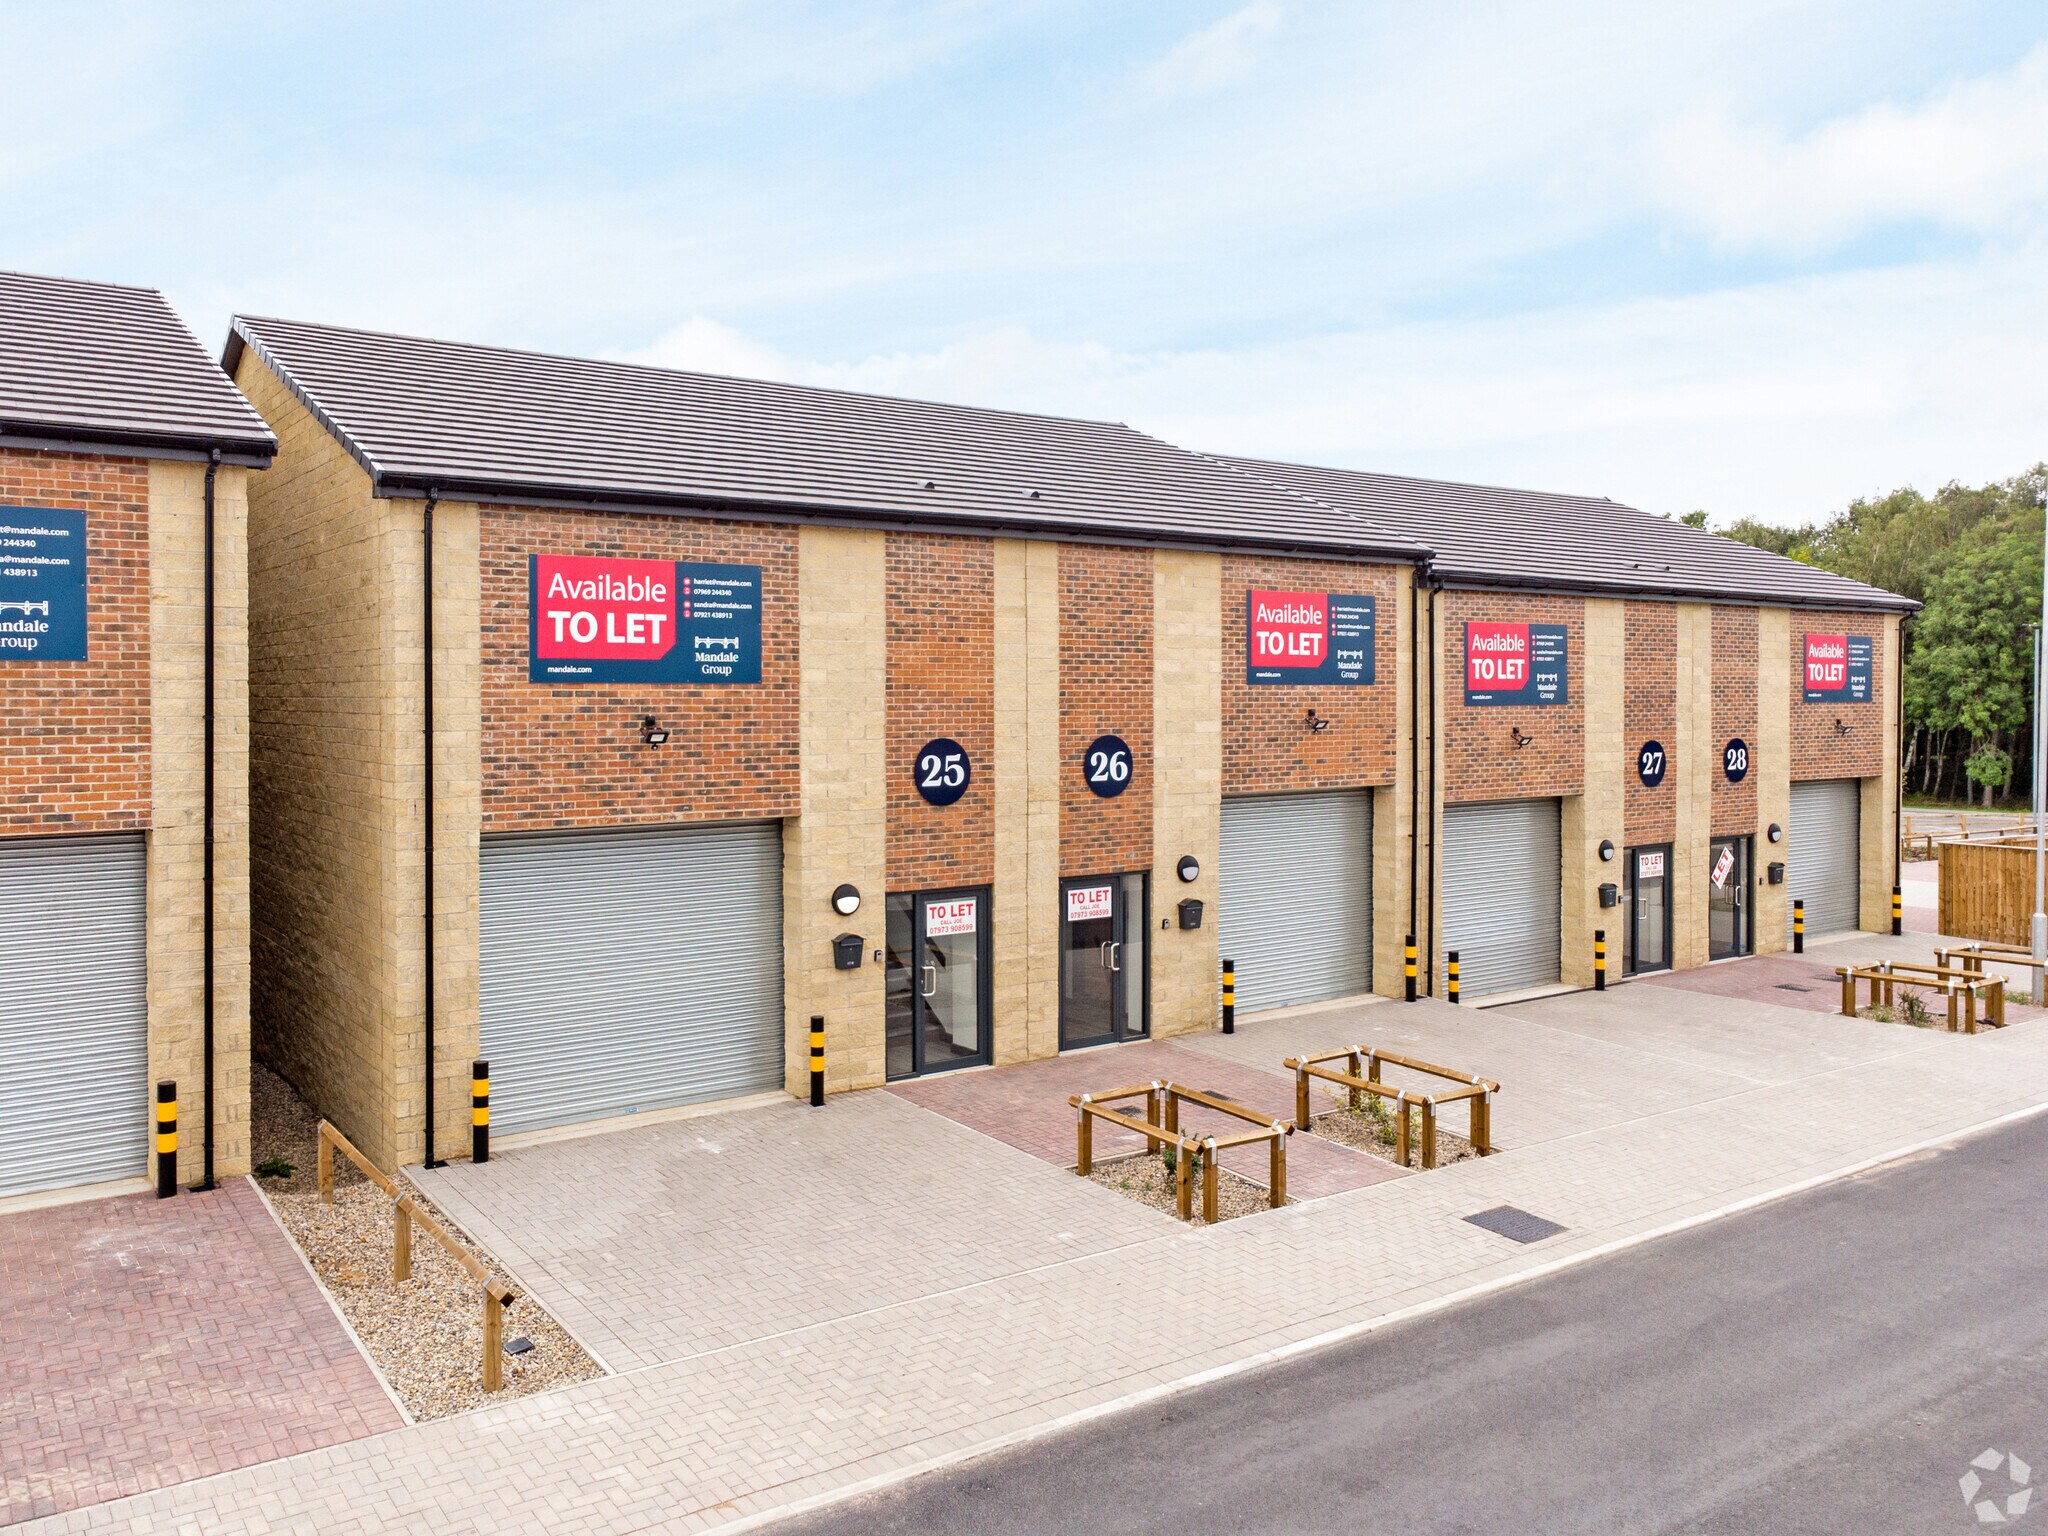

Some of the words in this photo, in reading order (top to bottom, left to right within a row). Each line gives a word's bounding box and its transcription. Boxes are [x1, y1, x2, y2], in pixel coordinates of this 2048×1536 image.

[3, 538, 37, 548] 244340
[3, 568, 38, 577] 438913
[547, 572, 667, 603] Available
[1256, 603, 1322, 625] Available
[547, 610, 598, 643] TO
[606, 612, 667, 644] LET
[0, 637, 38, 651] roup
[1256, 631, 1285, 655] TO
[1288, 632, 1323, 656] LET
[1472, 633, 1525, 652] Available
[1808, 643, 1844, 658] Available
[695, 652, 739, 662] Mandale
[1337, 661, 1362, 669] Mandale
[547, 665, 592, 673] mandale.com
[701, 664, 732, 676] Group
[1341, 670, 1359, 680] Group
[1472, 658, 1494, 680] TO
[1497, 658, 1525, 679] LET
[1808, 663, 1824, 681] TO
[1825, 664, 1844, 681] LET
[1090, 751, 1129, 782] 26
[1642, 752, 1663, 775] 27
[1727, 748, 1747, 770] 28
[921, 753, 965, 787] 25
[1640, 857, 1649, 866] TO
[1650, 855, 1663, 865] LET
[1713, 849, 1729, 882] LET
[1070, 892, 1085, 904] TO
[1089, 890, 1110, 903] LET
[929, 906, 947, 919] TO
[950, 903, 974, 917] LET
